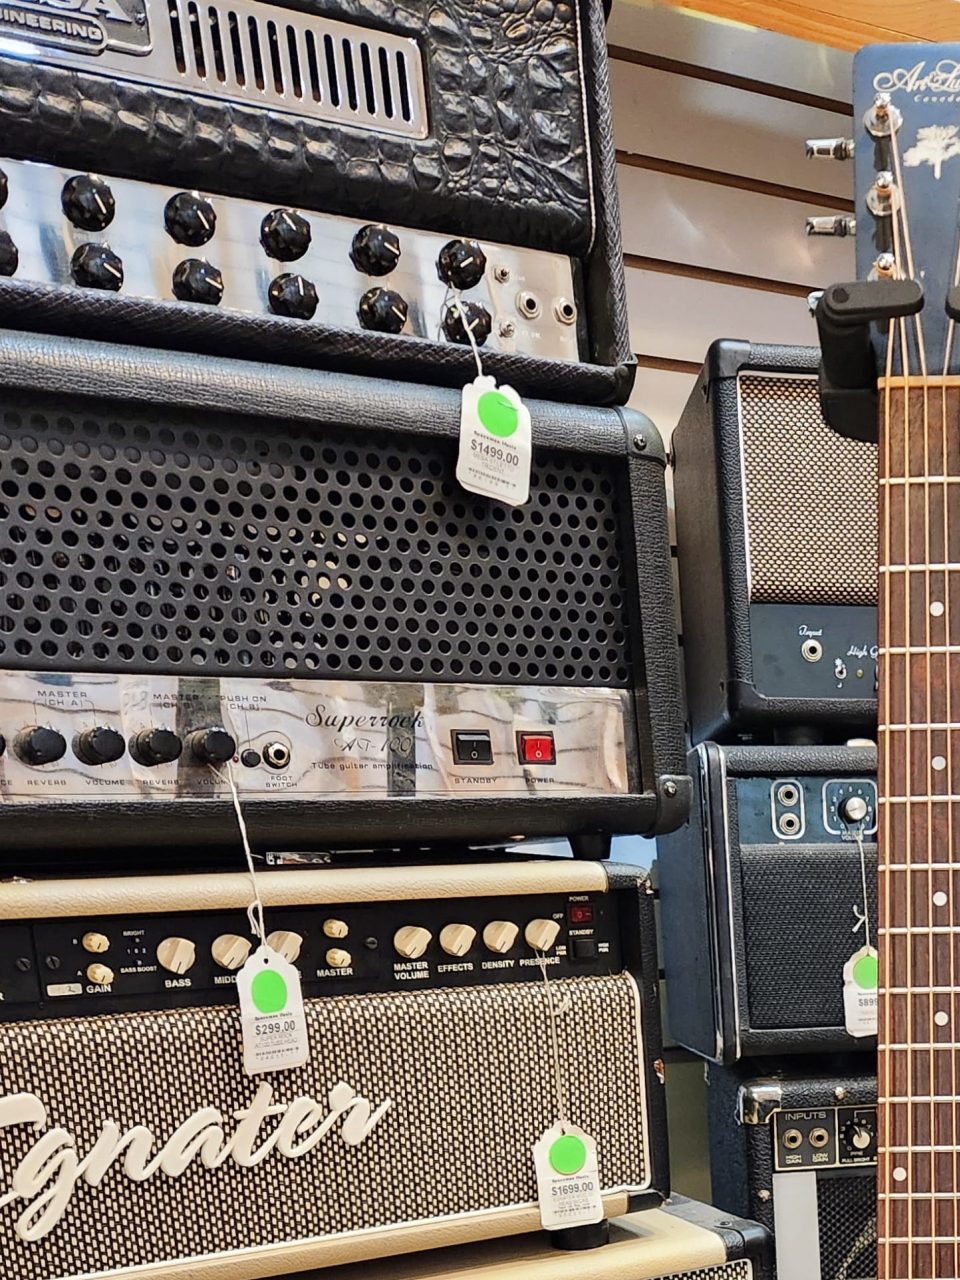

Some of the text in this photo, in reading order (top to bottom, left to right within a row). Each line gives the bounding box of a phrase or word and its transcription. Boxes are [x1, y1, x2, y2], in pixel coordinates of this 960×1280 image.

[0, 9, 102, 40] INEERING
[470, 440, 519, 466] $1499.00
[798, 625, 823, 637] Input
[847, 646, 868, 659] High
[153, 693, 199, 701] MASTER
[305, 704, 426, 730] Superrock
[312, 762, 335, 770] Tube
[339, 762, 368, 772] guitar
[394, 961, 429, 971] MASTER
[481, 959, 515, 970] DENSITY
[519, 956, 560, 967] PRESENCE
[317, 967, 354, 978] MASTER
[438, 962, 474, 973] EFFECTS
[214, 975, 237, 985] MIDD
[394, 970, 430, 981] VOLUME
[86, 984, 112, 994] GAIN
[165, 978, 192, 989] BASS
[255, 1020, 296, 1036] $299.00
[785, 1111, 827, 1120] INPUTS
[552, 1182, 594, 1196] $1699.00
